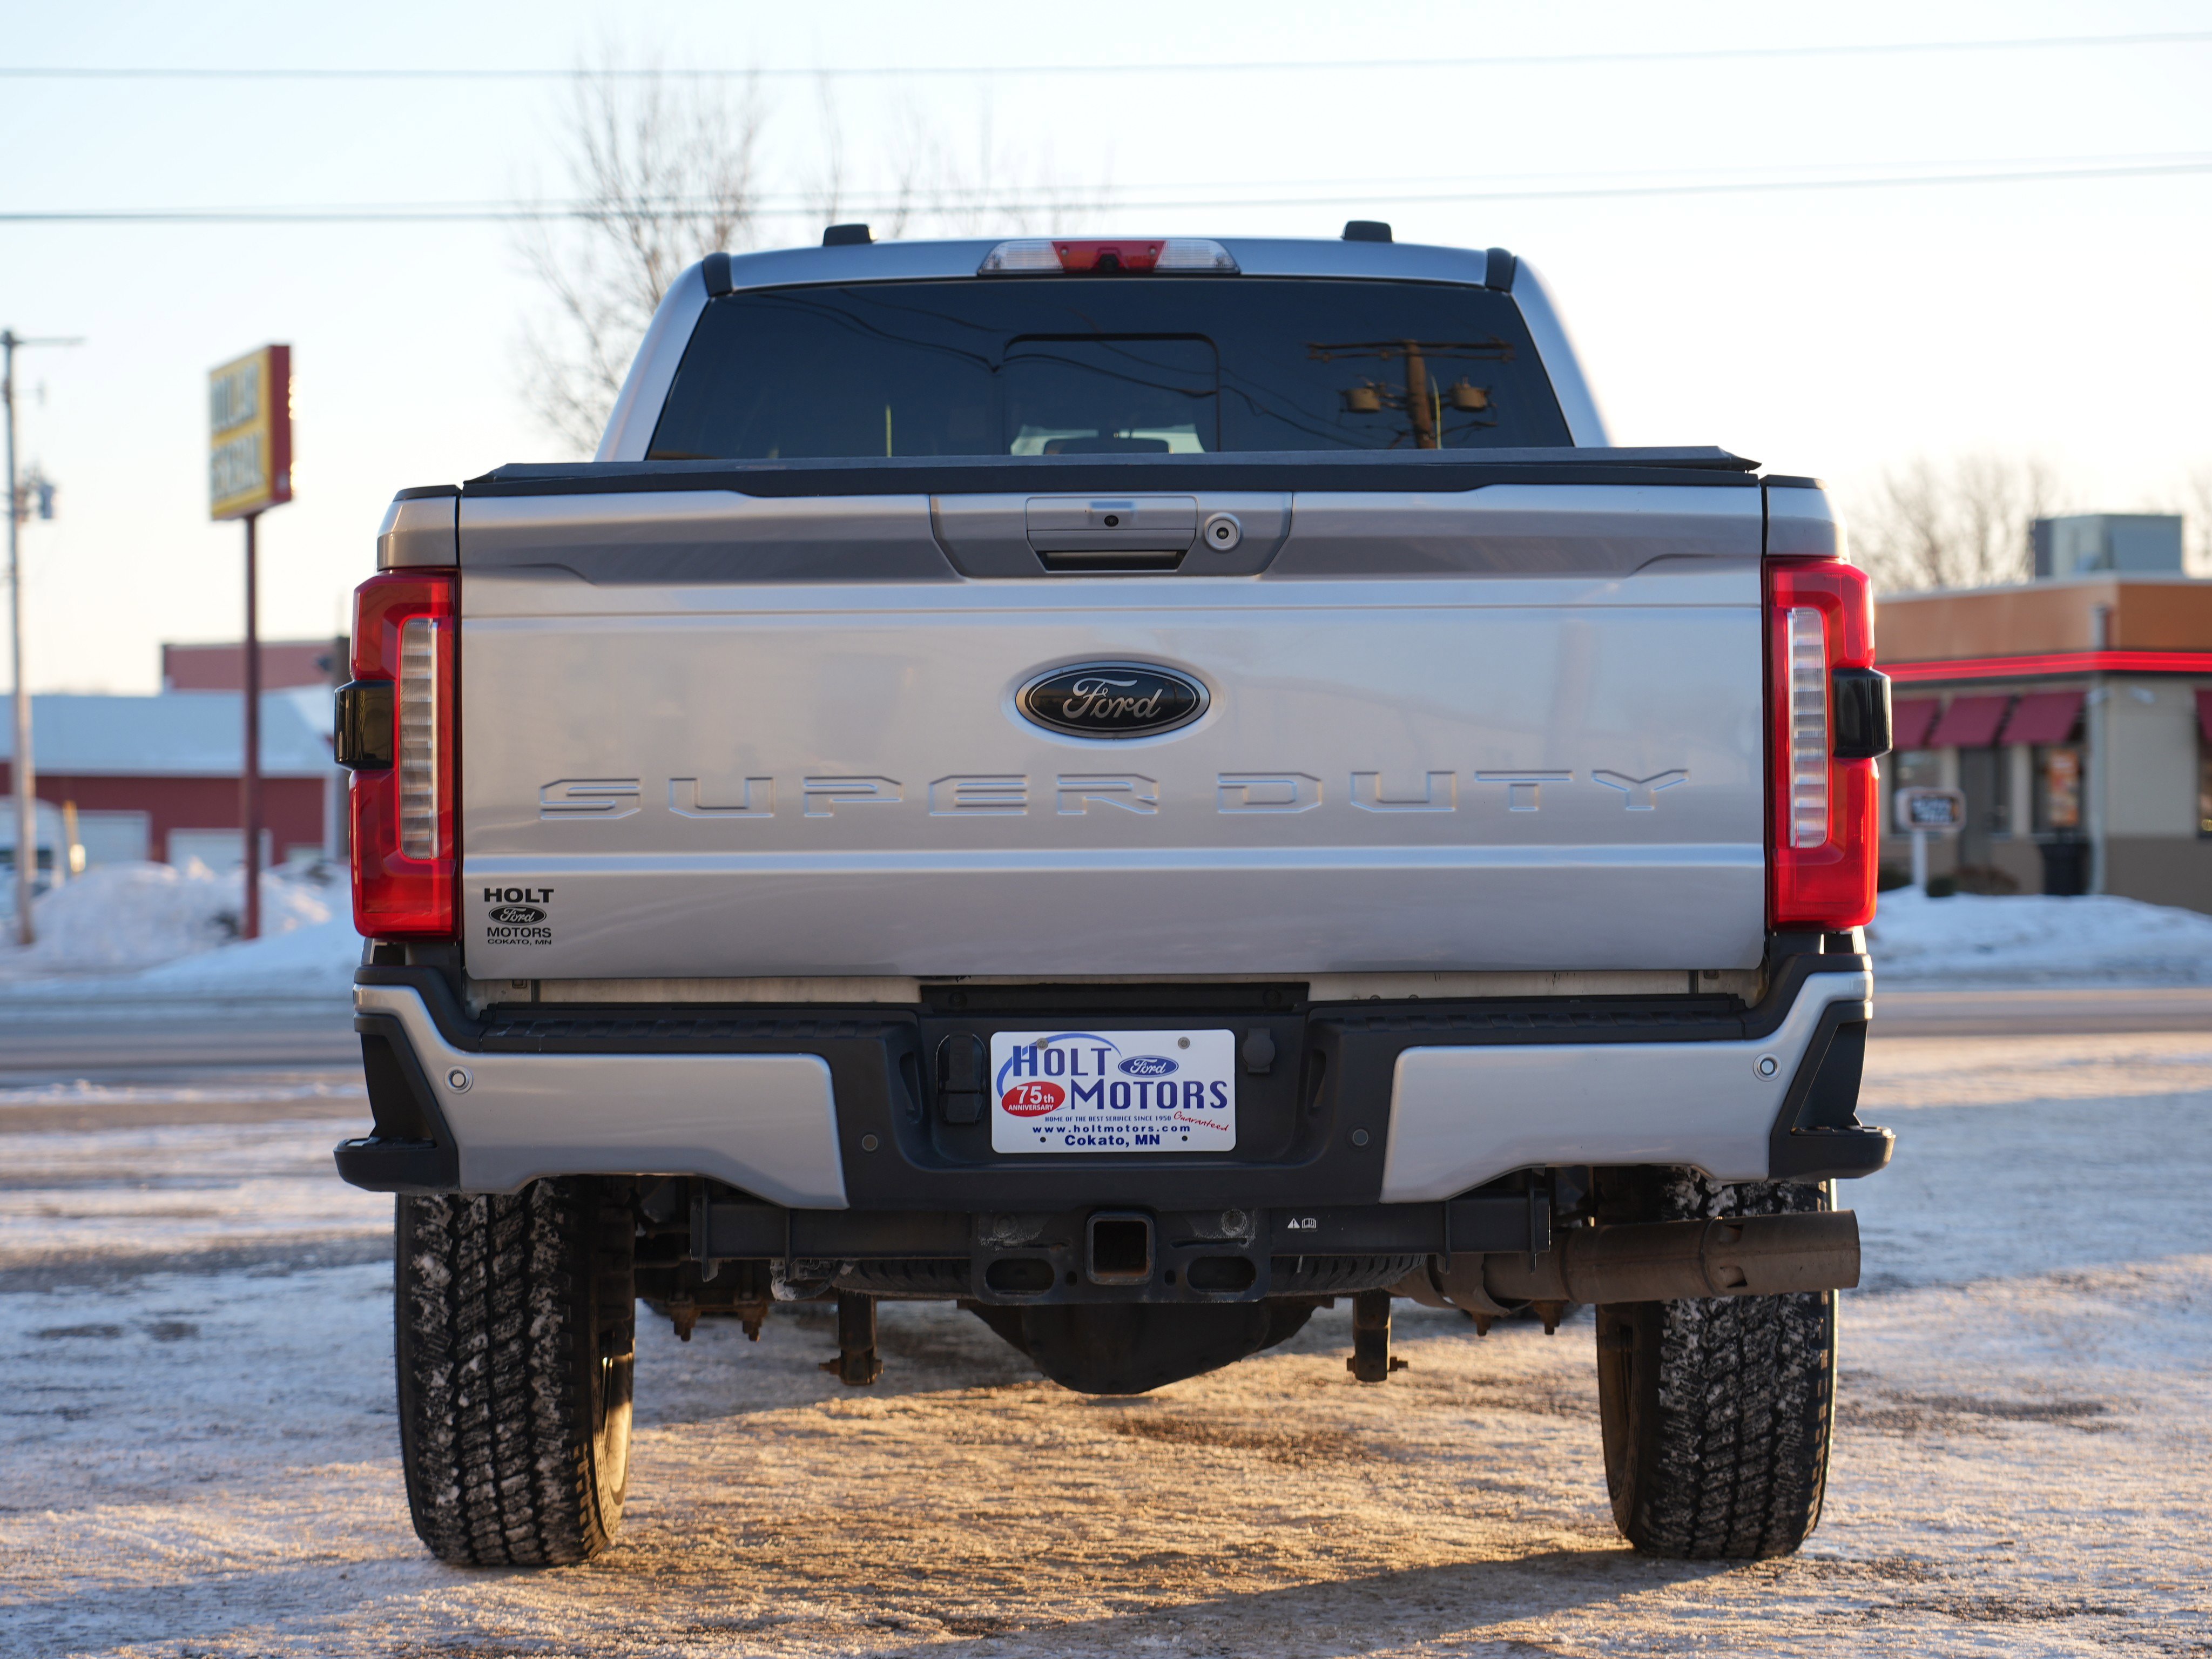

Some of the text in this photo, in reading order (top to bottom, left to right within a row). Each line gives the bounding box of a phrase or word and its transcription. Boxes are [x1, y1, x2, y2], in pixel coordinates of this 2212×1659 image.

[1062, 677, 1163, 718] Ford
[541, 769, 1689, 819] SUPER DUTY
[484, 888, 554, 903] HOLT
[500, 907, 535, 922] Ford
[487, 927, 551, 938] MOTORS
[1013, 1046, 1112, 1076] HOLT
[1130, 1058, 1167, 1074] Ford
[1016, 1085, 1054, 1104] 75th
[1071, 1078, 1228, 1110] MOTORS
[1033, 1124, 1190, 1133] www.holtmotors.com
[1174, 1110, 1230, 1132] Guaranteed
[1065, 1134, 1160, 1148] Cokato, MN
